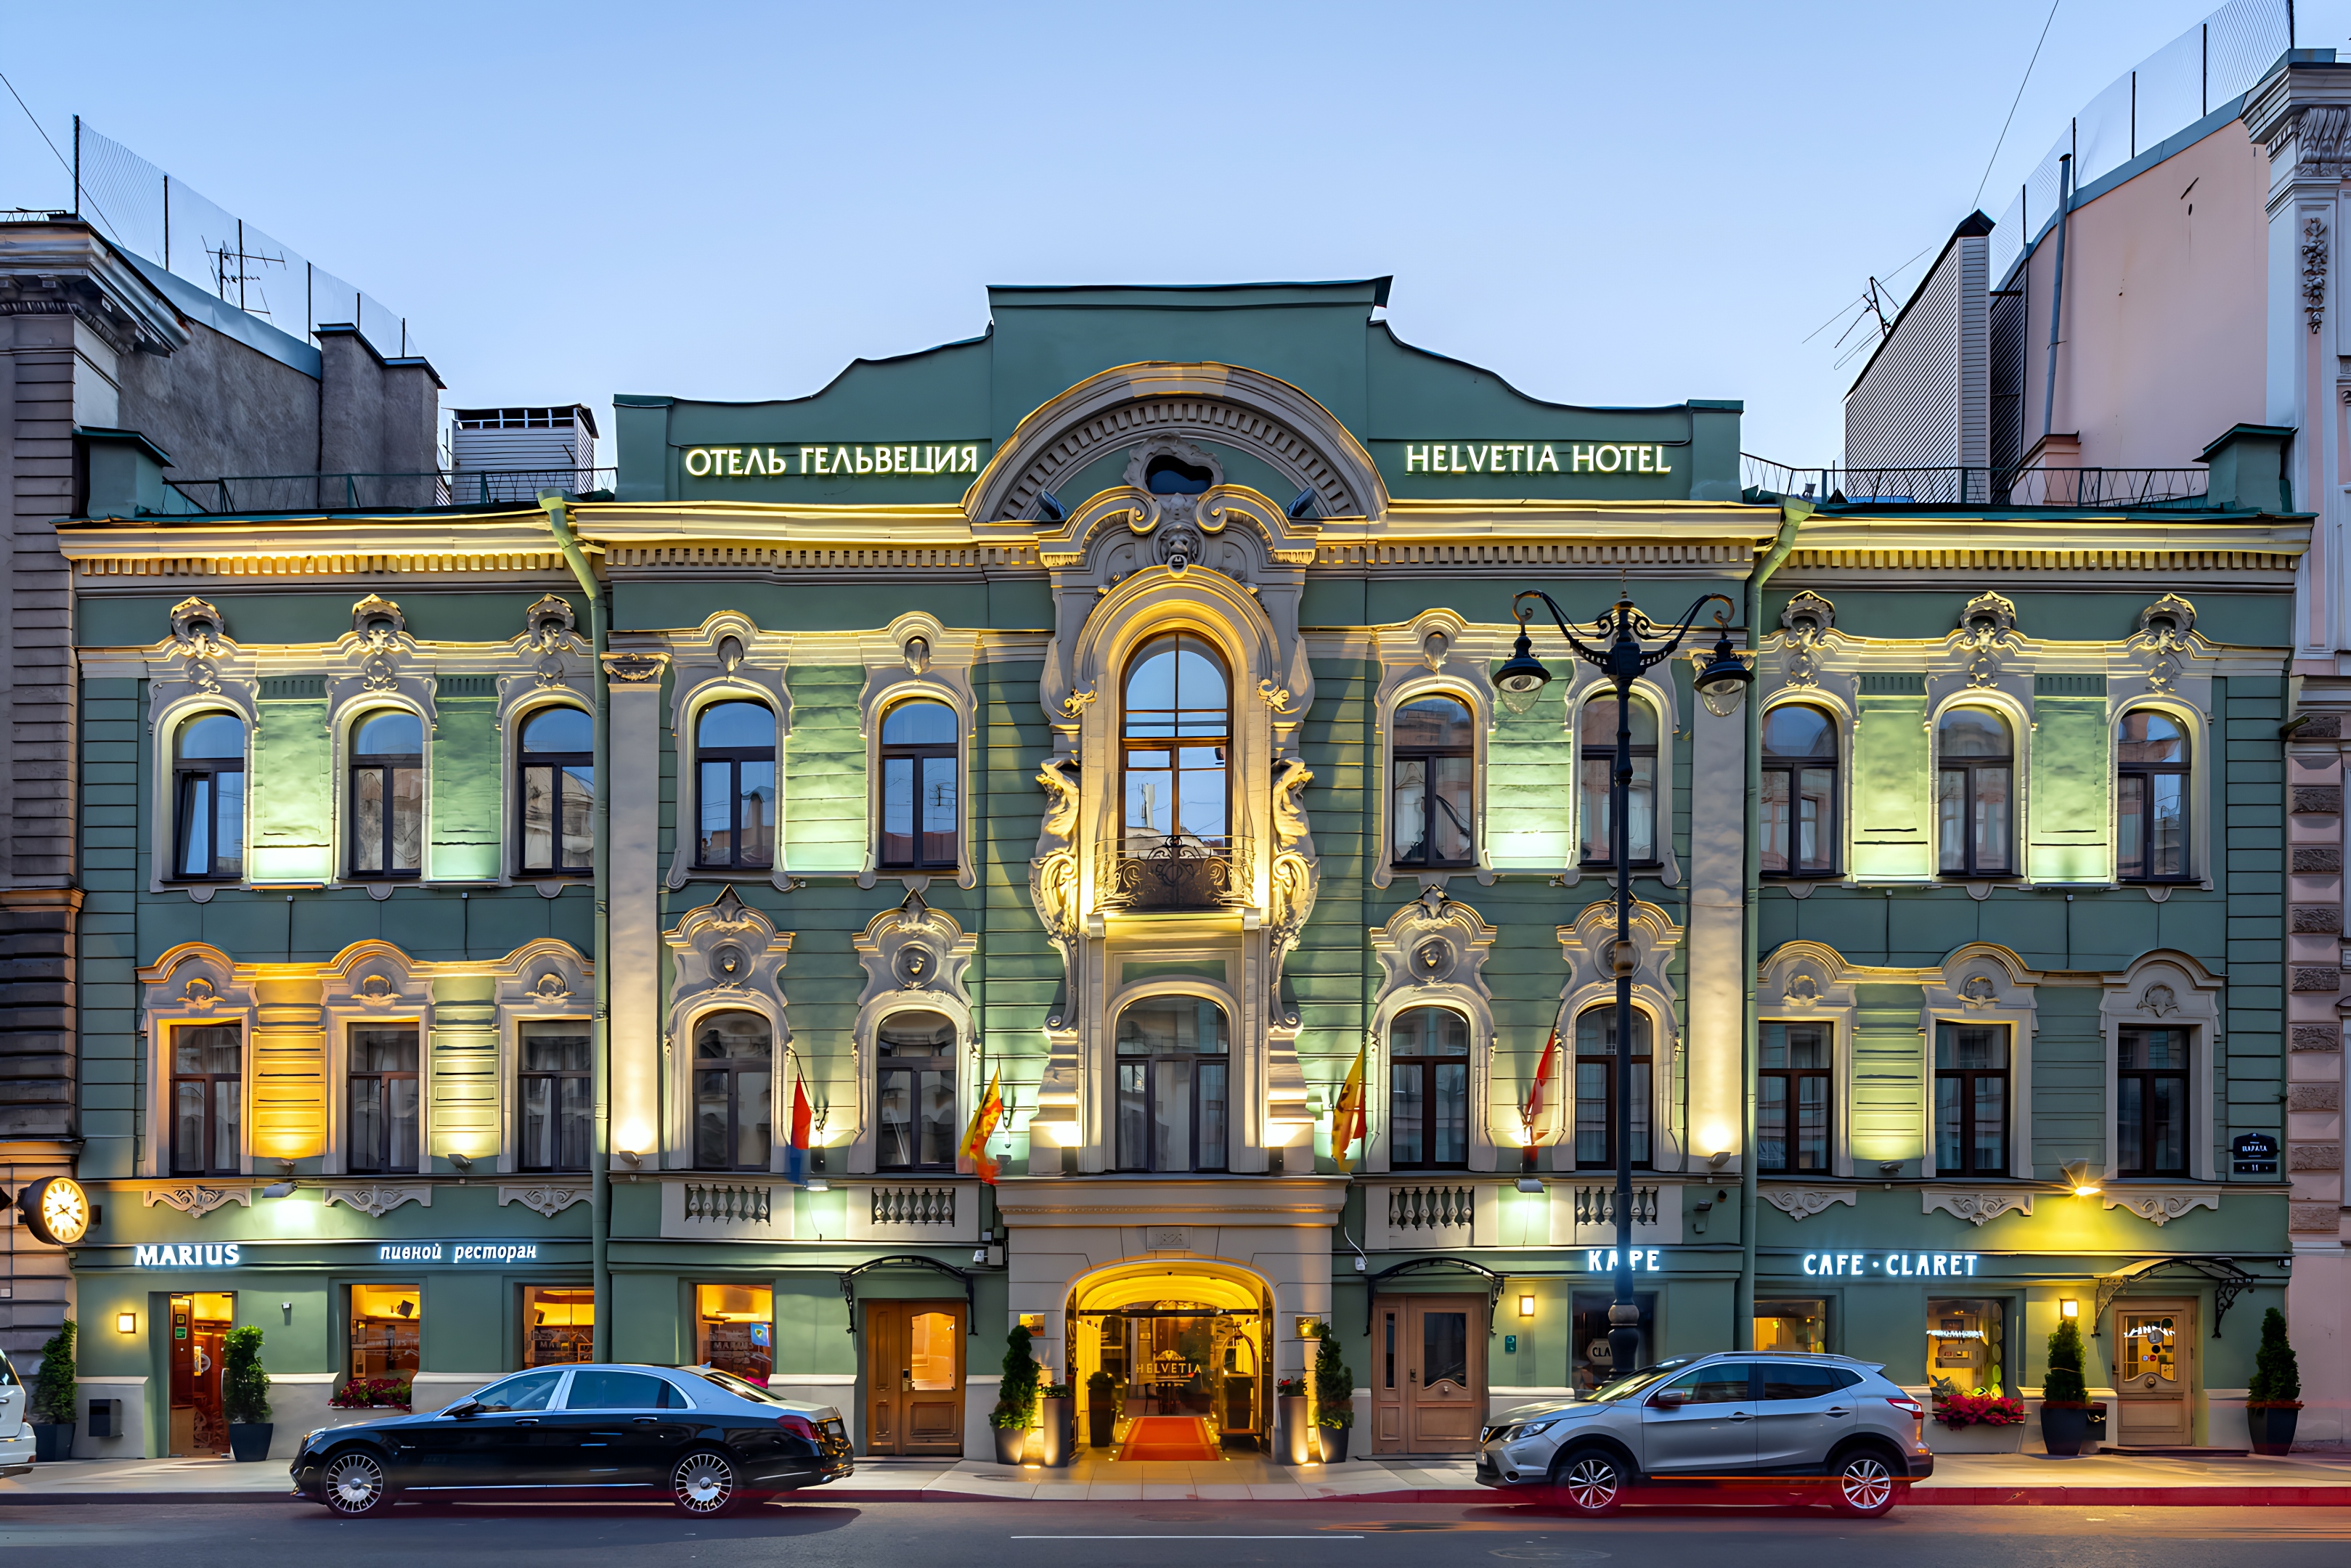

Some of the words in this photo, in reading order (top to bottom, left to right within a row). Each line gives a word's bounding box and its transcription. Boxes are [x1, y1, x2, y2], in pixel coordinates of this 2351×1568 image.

[685, 448, 786, 475] ОТЕЛЬ
[800, 446, 977, 474] ГЕЛЬВЕЦИЯ
[1406, 445, 1560, 473] HELVETIA
[1573, 444, 1671, 473] HOTEL
[134, 1244, 240, 1266] MARIUS
[380, 1243, 441, 1259] пивной
[453, 1245, 537, 1263] ресторан
[1803, 1254, 1864, 1275] CAFE
[1886, 1254, 1977, 1275] CLARET
[1136, 1363, 1202, 1374] HELVETIA
